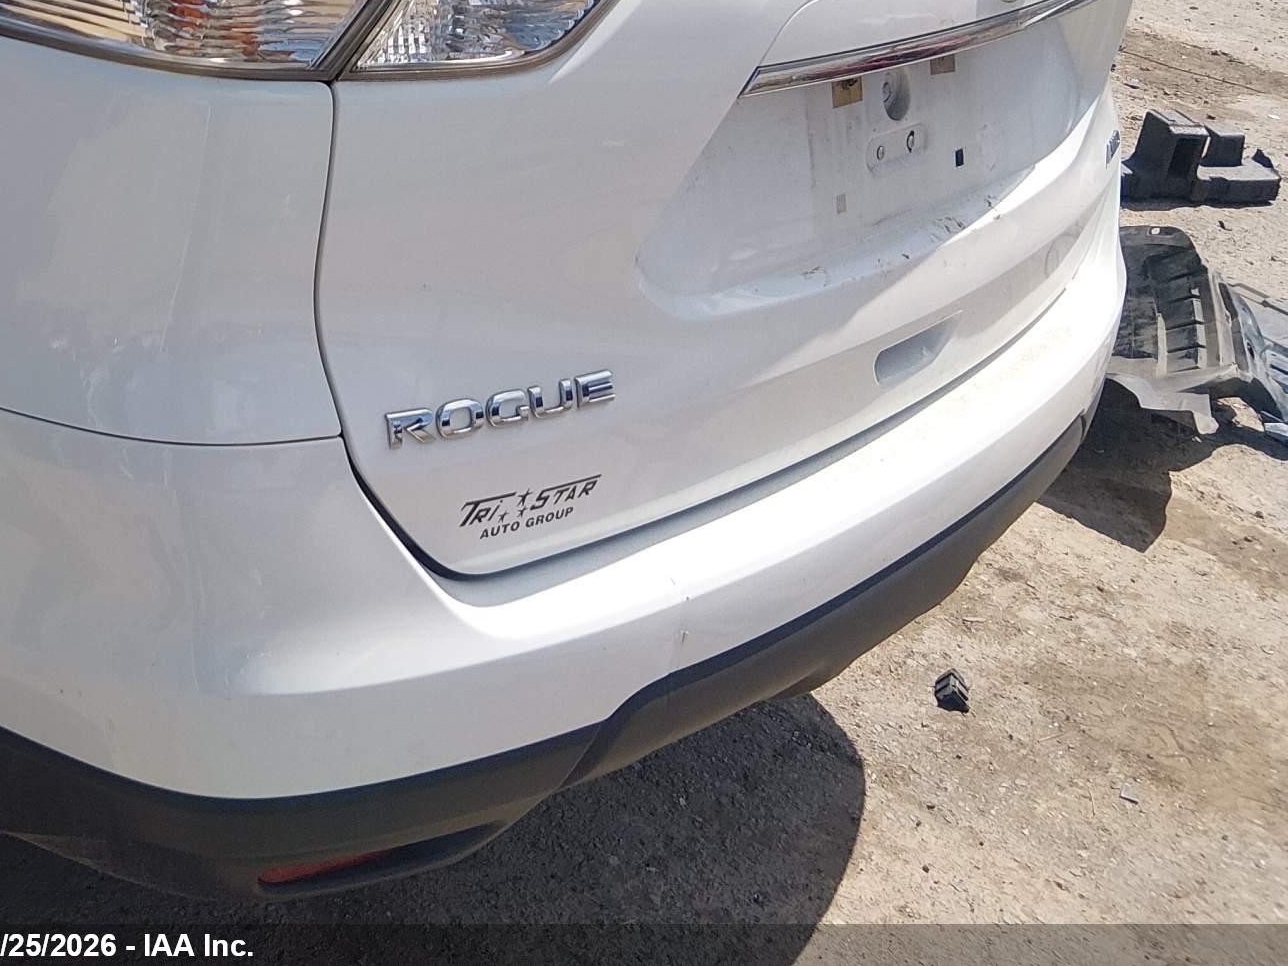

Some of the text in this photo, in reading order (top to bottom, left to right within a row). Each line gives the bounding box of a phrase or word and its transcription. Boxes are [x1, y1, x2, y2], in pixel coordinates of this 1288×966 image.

[384, 369, 616, 450] ROGUE
[529, 474, 602, 511] STAR
[480, 507, 574, 539] AUTO GROUP
